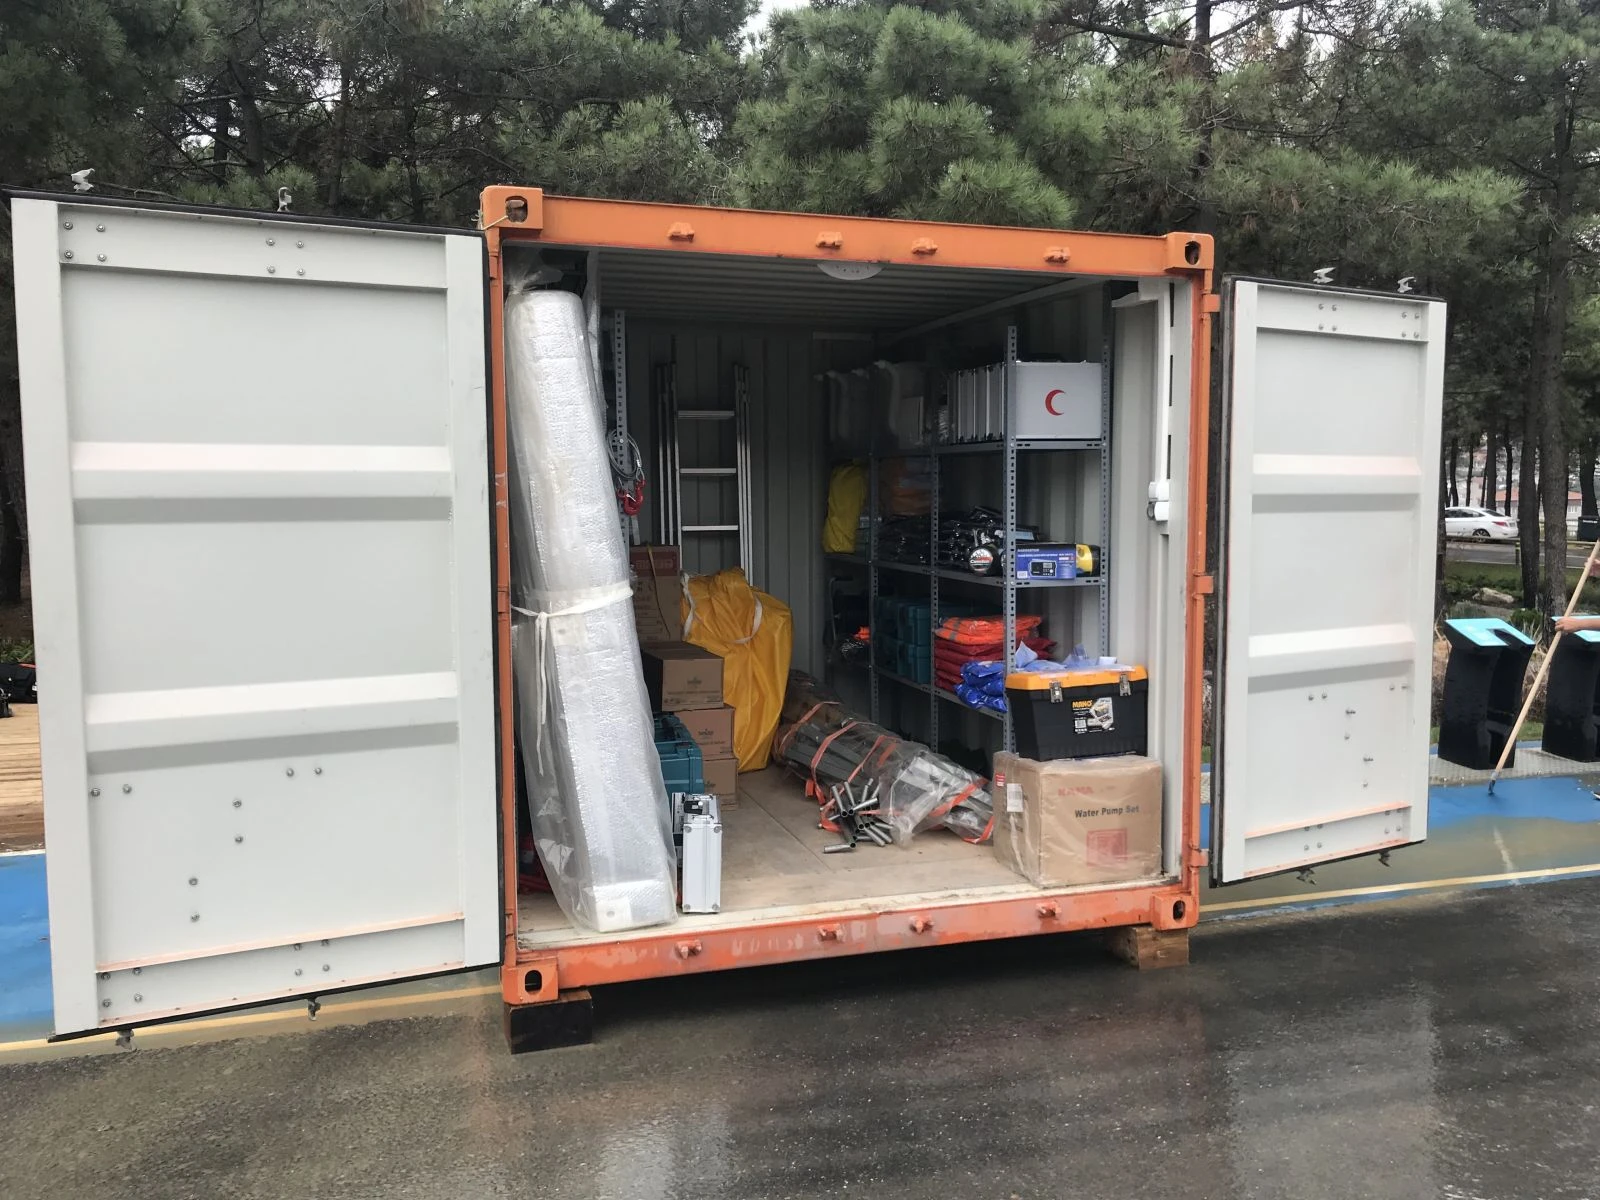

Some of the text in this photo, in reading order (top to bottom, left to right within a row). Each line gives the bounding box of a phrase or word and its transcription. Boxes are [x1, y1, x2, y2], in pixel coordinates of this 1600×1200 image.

[1075, 805, 1139, 818] Water Pump Set
